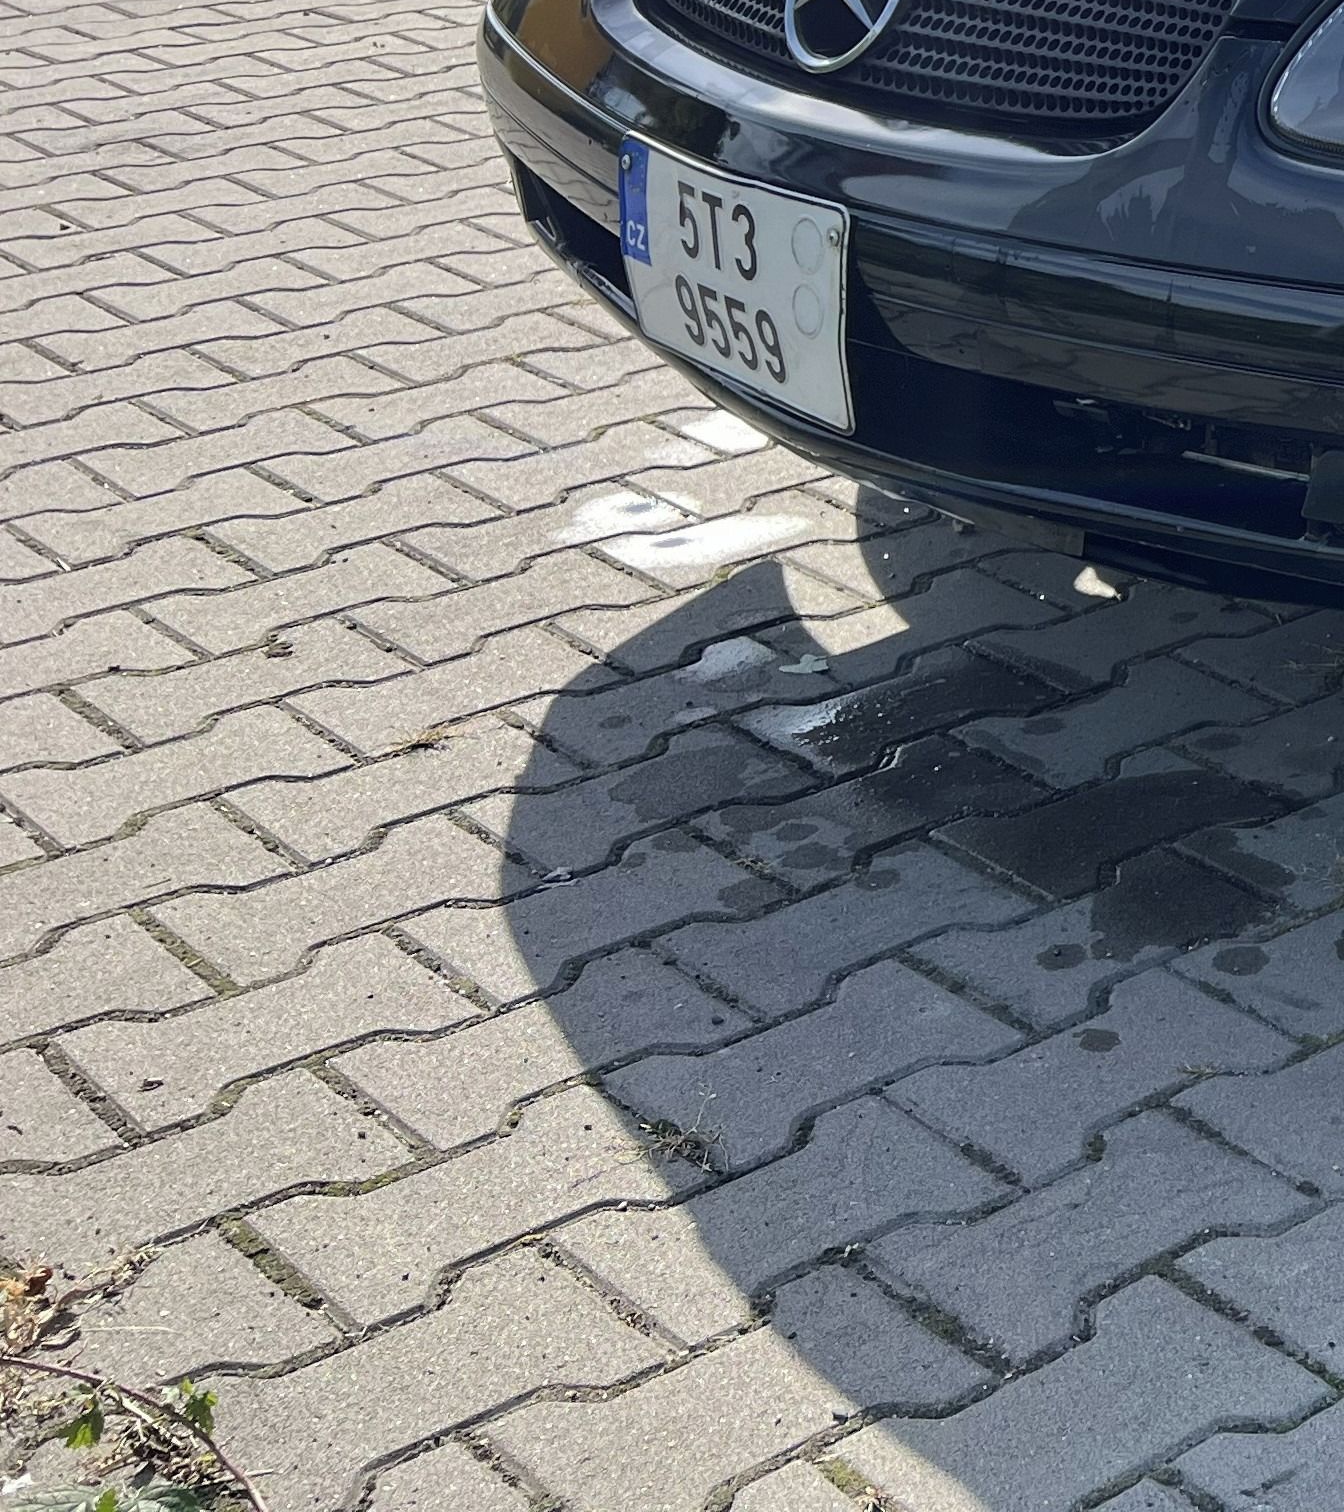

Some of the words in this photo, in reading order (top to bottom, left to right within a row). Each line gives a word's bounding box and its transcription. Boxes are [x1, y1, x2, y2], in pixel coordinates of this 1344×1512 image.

[626, 220, 646, 251] CZ
[678, 180, 758, 282] 5T3
[675, 274, 787, 384] 9559
